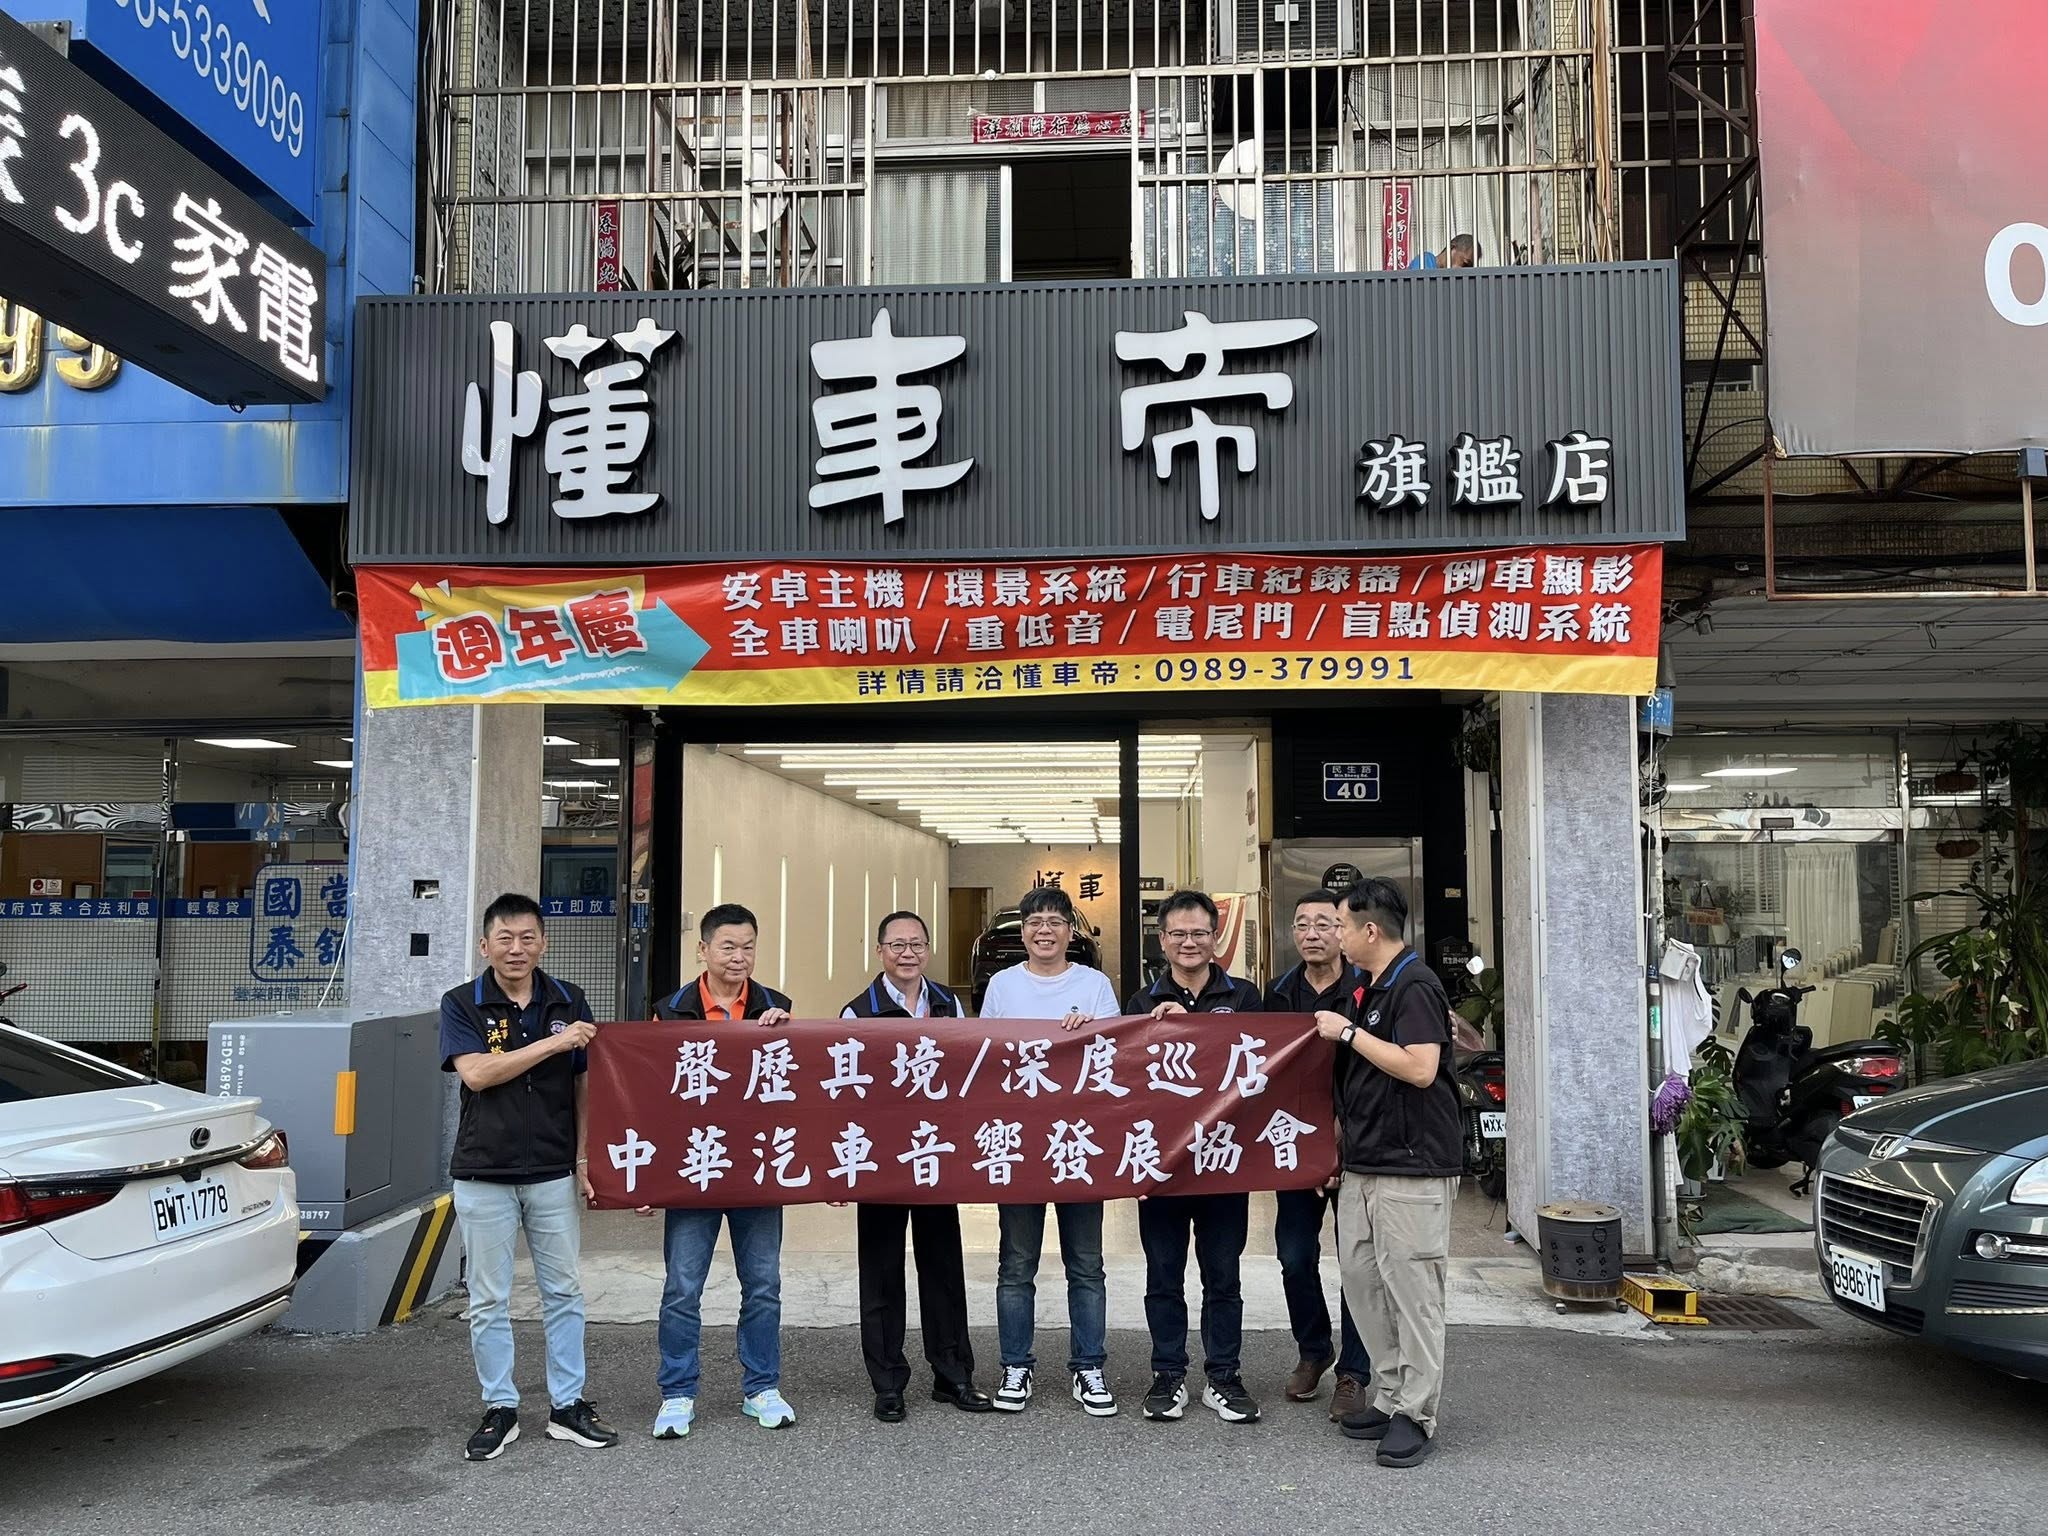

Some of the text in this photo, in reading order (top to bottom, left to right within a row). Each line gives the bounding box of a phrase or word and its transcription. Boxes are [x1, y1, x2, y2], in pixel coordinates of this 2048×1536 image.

[599, 211, 618, 292] 春滿乾
[462, 307, 1612, 525] 懂車帝 旗艦店
[434, 587, 648, 682] 週年慶
[1332, 766, 1371, 774] 民生路
[1337, 782, 1367, 799] 40
[607, 1109, 1318, 1193] 中華汽車音響發展協會
[154, 1184, 229, 1231] BWT-1778
[1833, 1261, 1880, 1303] 8986-YT
